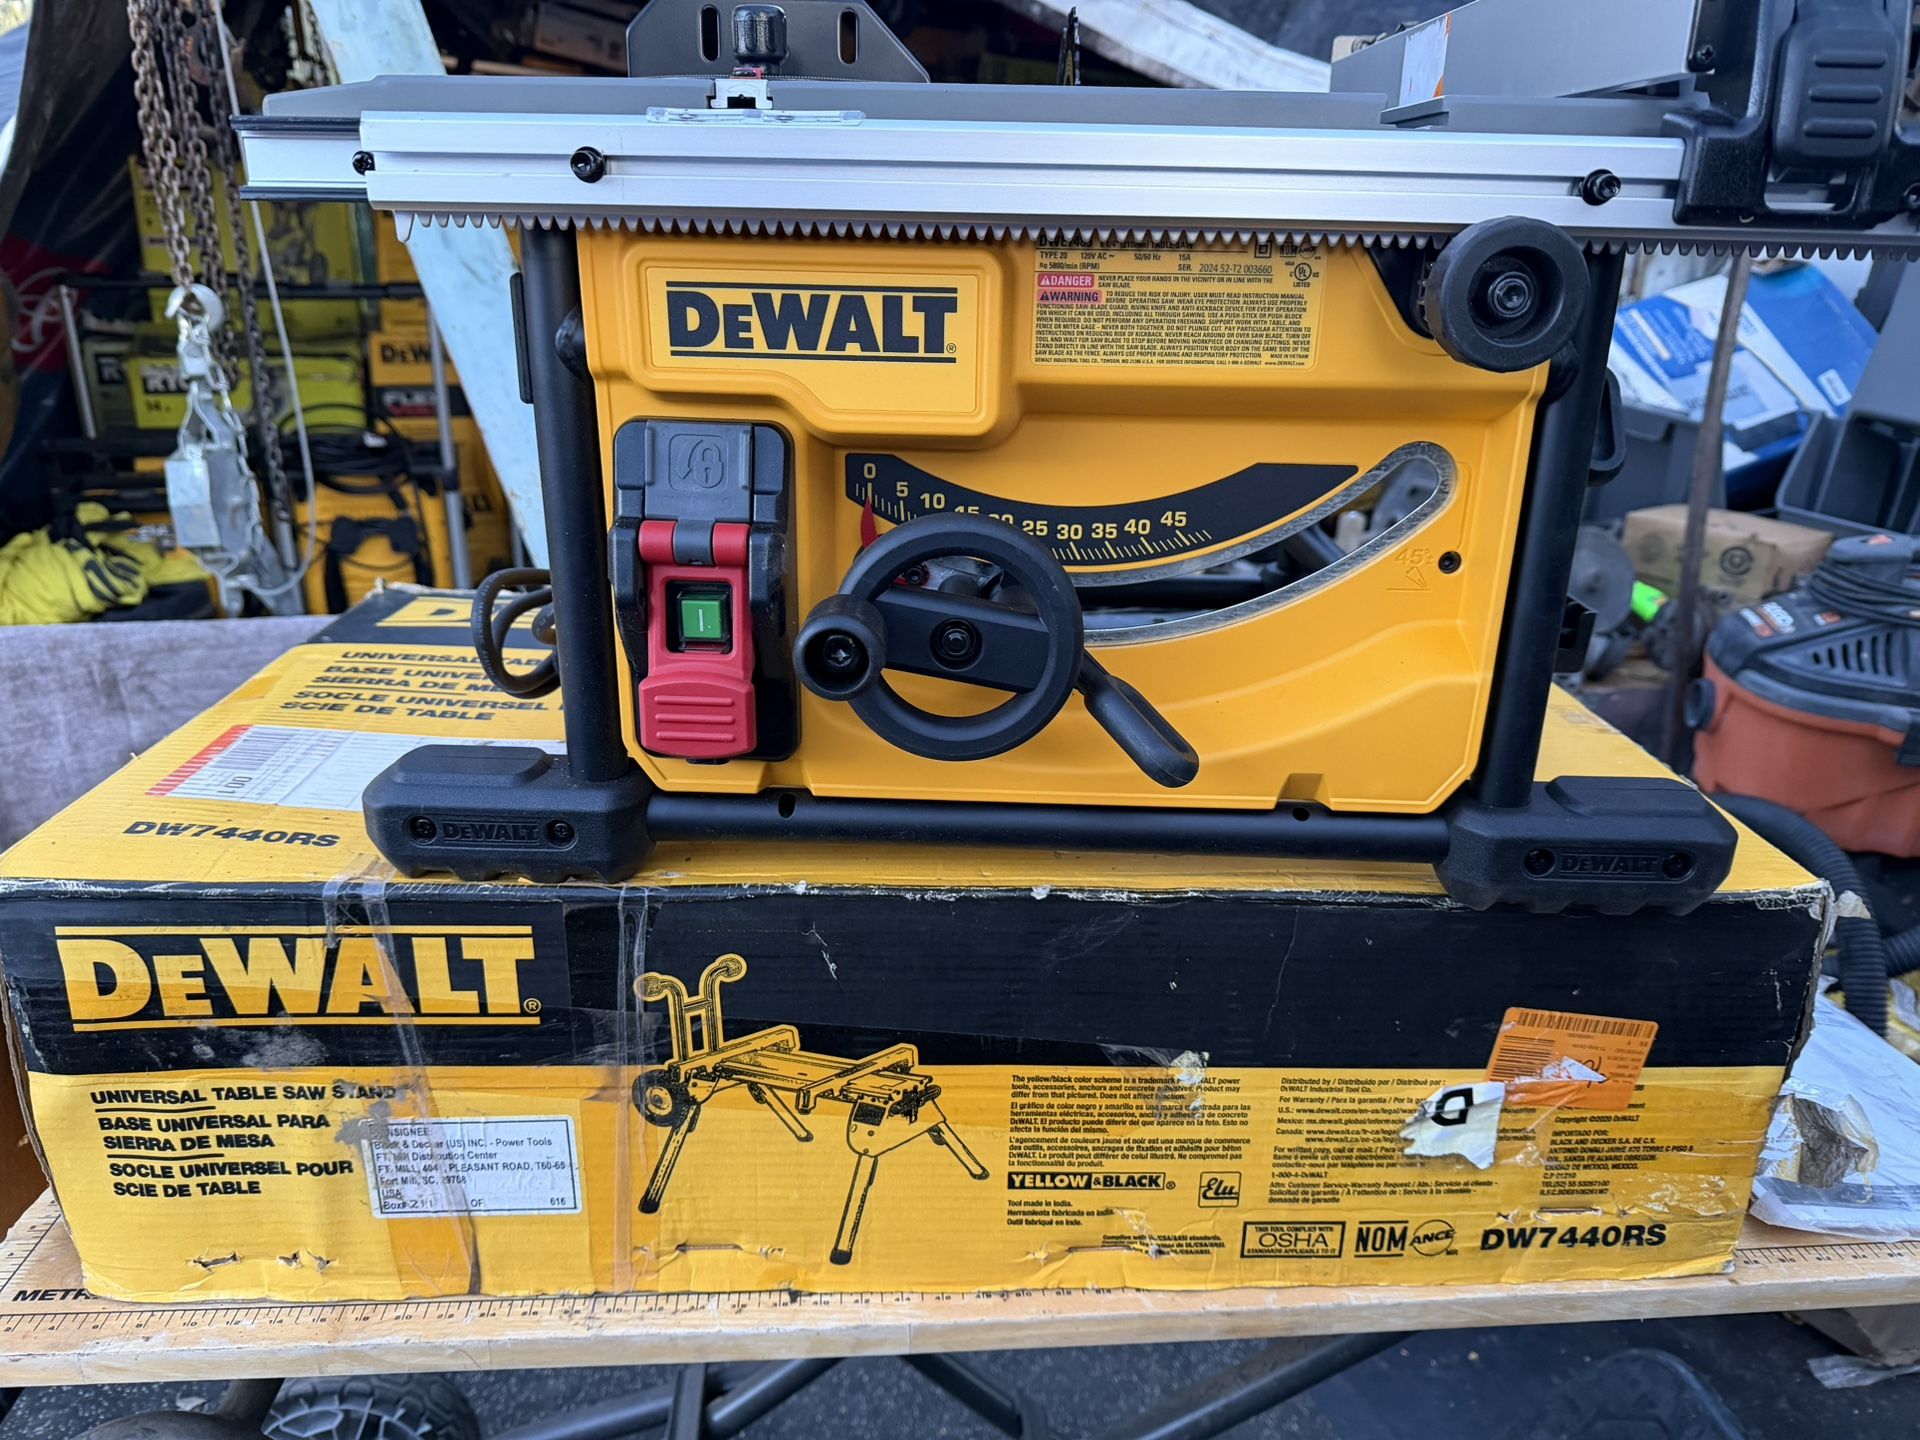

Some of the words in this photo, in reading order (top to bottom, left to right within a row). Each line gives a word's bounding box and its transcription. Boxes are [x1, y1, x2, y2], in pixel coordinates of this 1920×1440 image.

[1199, 264, 1218, 272] 2024
[1244, 265, 1273, 273] 003660
[1051, 275, 1092, 286] DANGER
[1050, 291, 1098, 302] WARNING
[863, 463, 876, 479] 0
[896, 482, 908, 498] 5
[920, 493, 945, 510] 10
[1124, 519, 1151, 535] 40
[1161, 511, 1187, 528] 45
[1022, 520, 1048, 536] 25
[1056, 524, 1082, 540] 30
[1091, 523, 1117, 539] 35
[324, 665, 394, 677] BASE
[312, 676, 411, 689] SIERRA
[420, 680, 458, 690] DE
[293, 690, 389, 703] SOCLE
[396, 695, 549, 711] UNIVERSEL
[281, 702, 346, 712] SCIE
[355, 704, 396, 715] DE
[405, 707, 496, 720] TABLE
[123, 821, 341, 847] DW7440RS
[90, 1089, 207, 1105] UNIVERSAL
[212, 1086, 278, 1100] TABLE
[284, 1085, 326, 1100] SAW
[332, 1085, 397, 1100] SAND
[98, 1117, 152, 1132] BASE
[158, 1114, 272, 1133] UNIVERSAL
[277, 1113, 331, 1129] PARA
[103, 1135, 176, 1152] SIERRA
[181, 1135, 211, 1151] DE
[216, 1133, 276, 1149] MESA
[495, 1138, 523, 1147] Power
[527, 1137, 552, 1146] Tools
[467, 1151, 498, 1160] Center
[110, 1162, 176, 1179] SOCLE
[179, 1161, 292, 1179] UNIVERSEL
[300, 1159, 354, 1176] POUR
[449, 1162, 500, 1172] PLEASANT
[502, 1161, 534, 1172] ROAD,
[113, 1181, 158, 1197] SCIE
[163, 1182, 192, 1197] DE
[196, 1180, 261, 1195] TABLE
[1011, 1174, 1088, 1188] YELLOW
[1092, 1176, 1102, 1186] &
[1103, 1174, 1162, 1188] BLACK
[1259, 1232, 1328, 1247] OSHA
[1355, 1226, 1408, 1252] NOM
[1410, 1228, 1455, 1246] ANCE
[1480, 1224, 1667, 1250] DW7440RS
